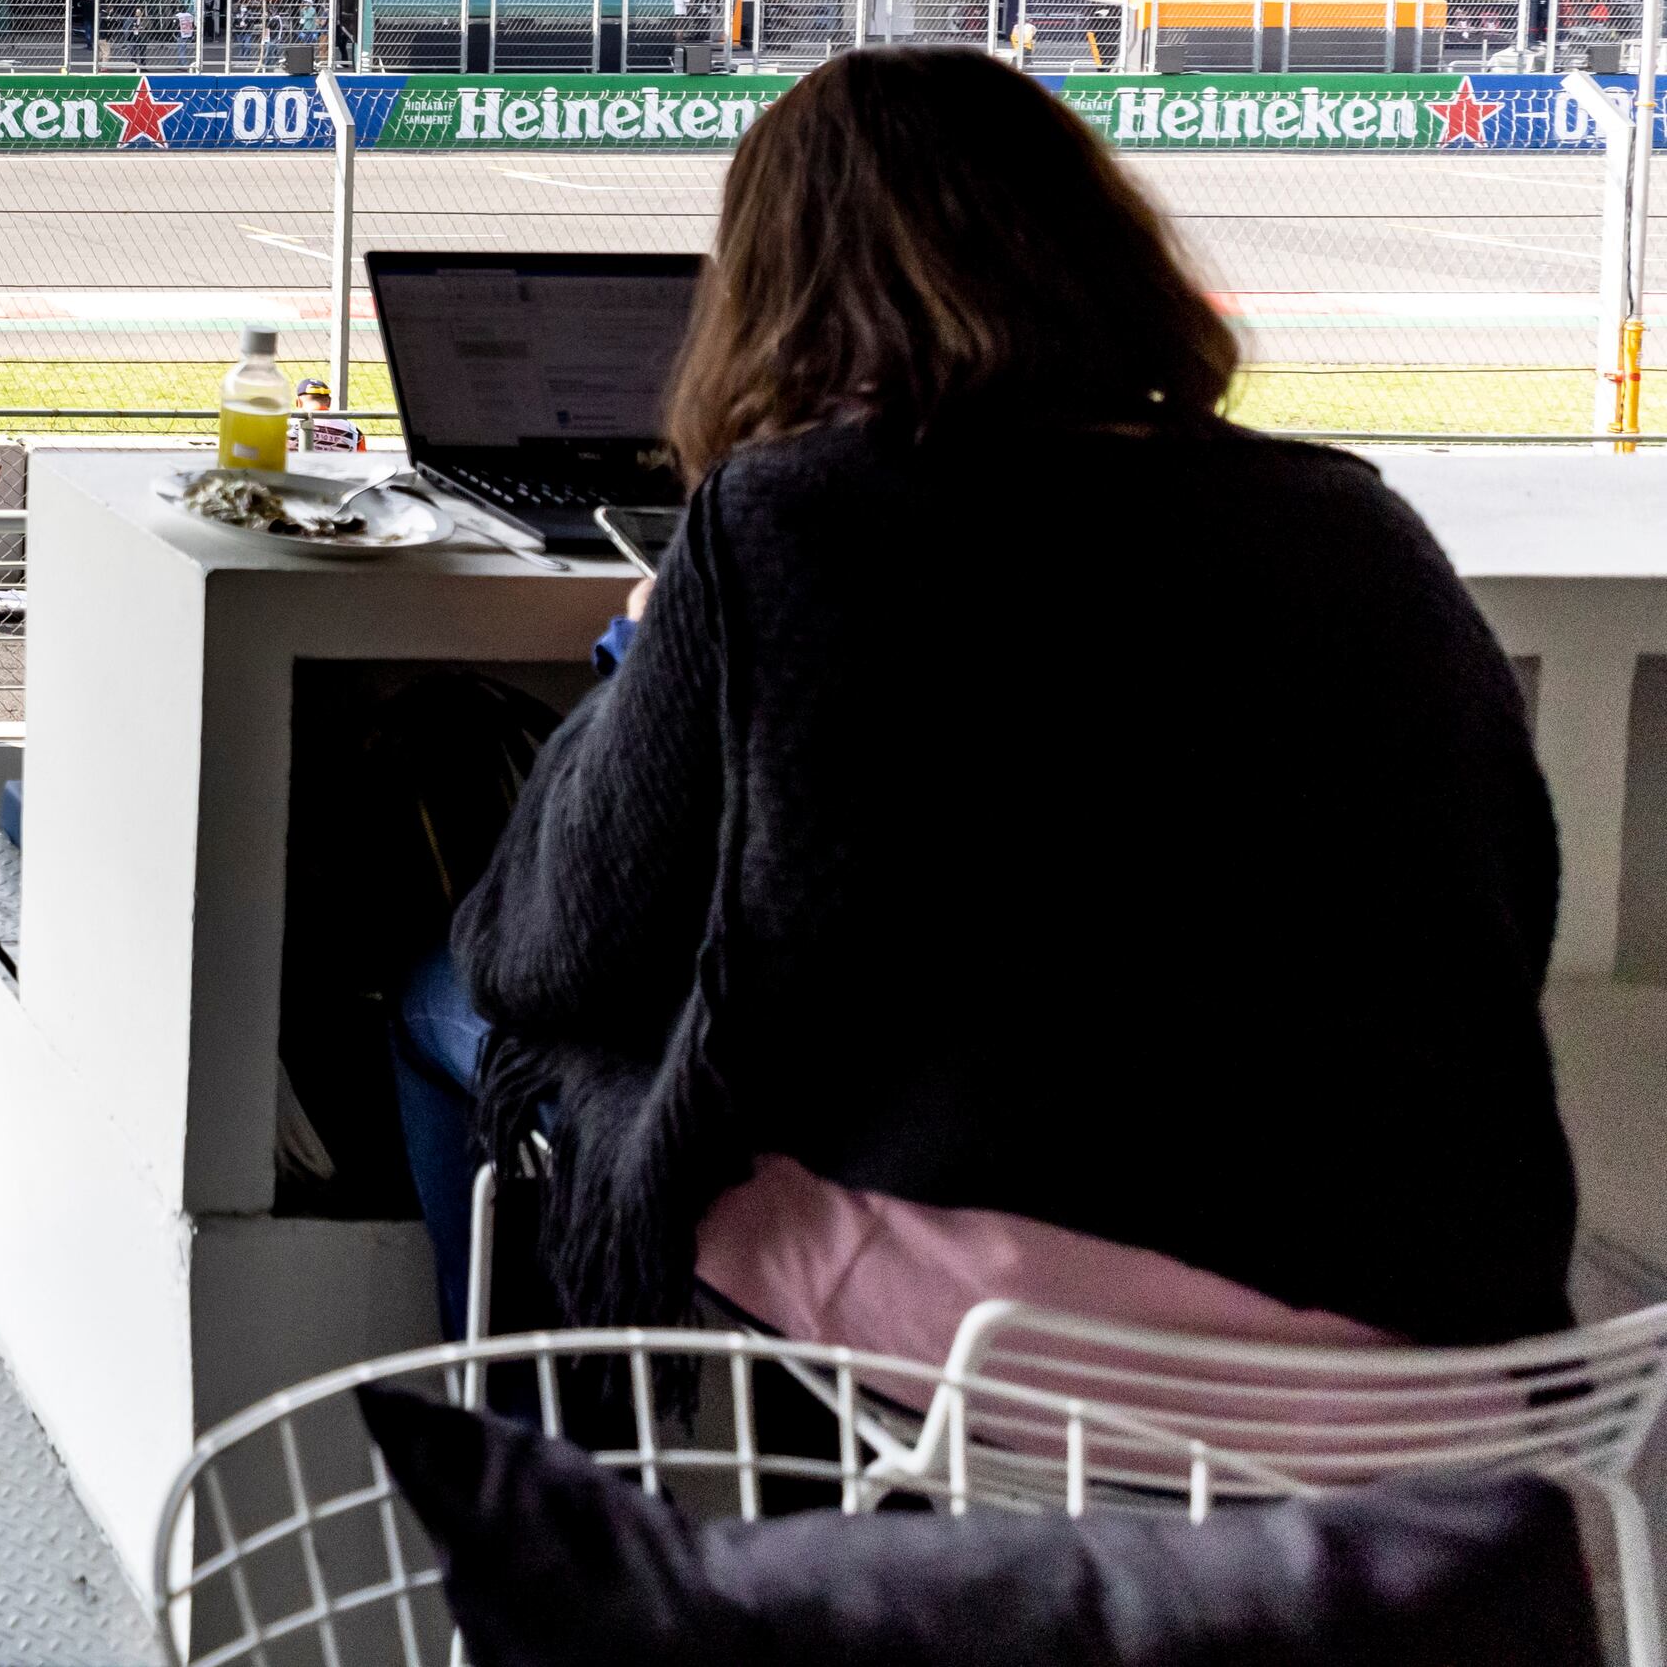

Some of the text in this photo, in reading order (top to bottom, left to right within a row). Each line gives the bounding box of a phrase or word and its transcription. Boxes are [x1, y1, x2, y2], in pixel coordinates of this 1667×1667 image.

[232, 86, 308, 143] 0.0
[404, 114, 453, 125] SANAMENTE
[456, 87, 755, 139] Heineken
[1114, 87, 1418, 139] Heineken
